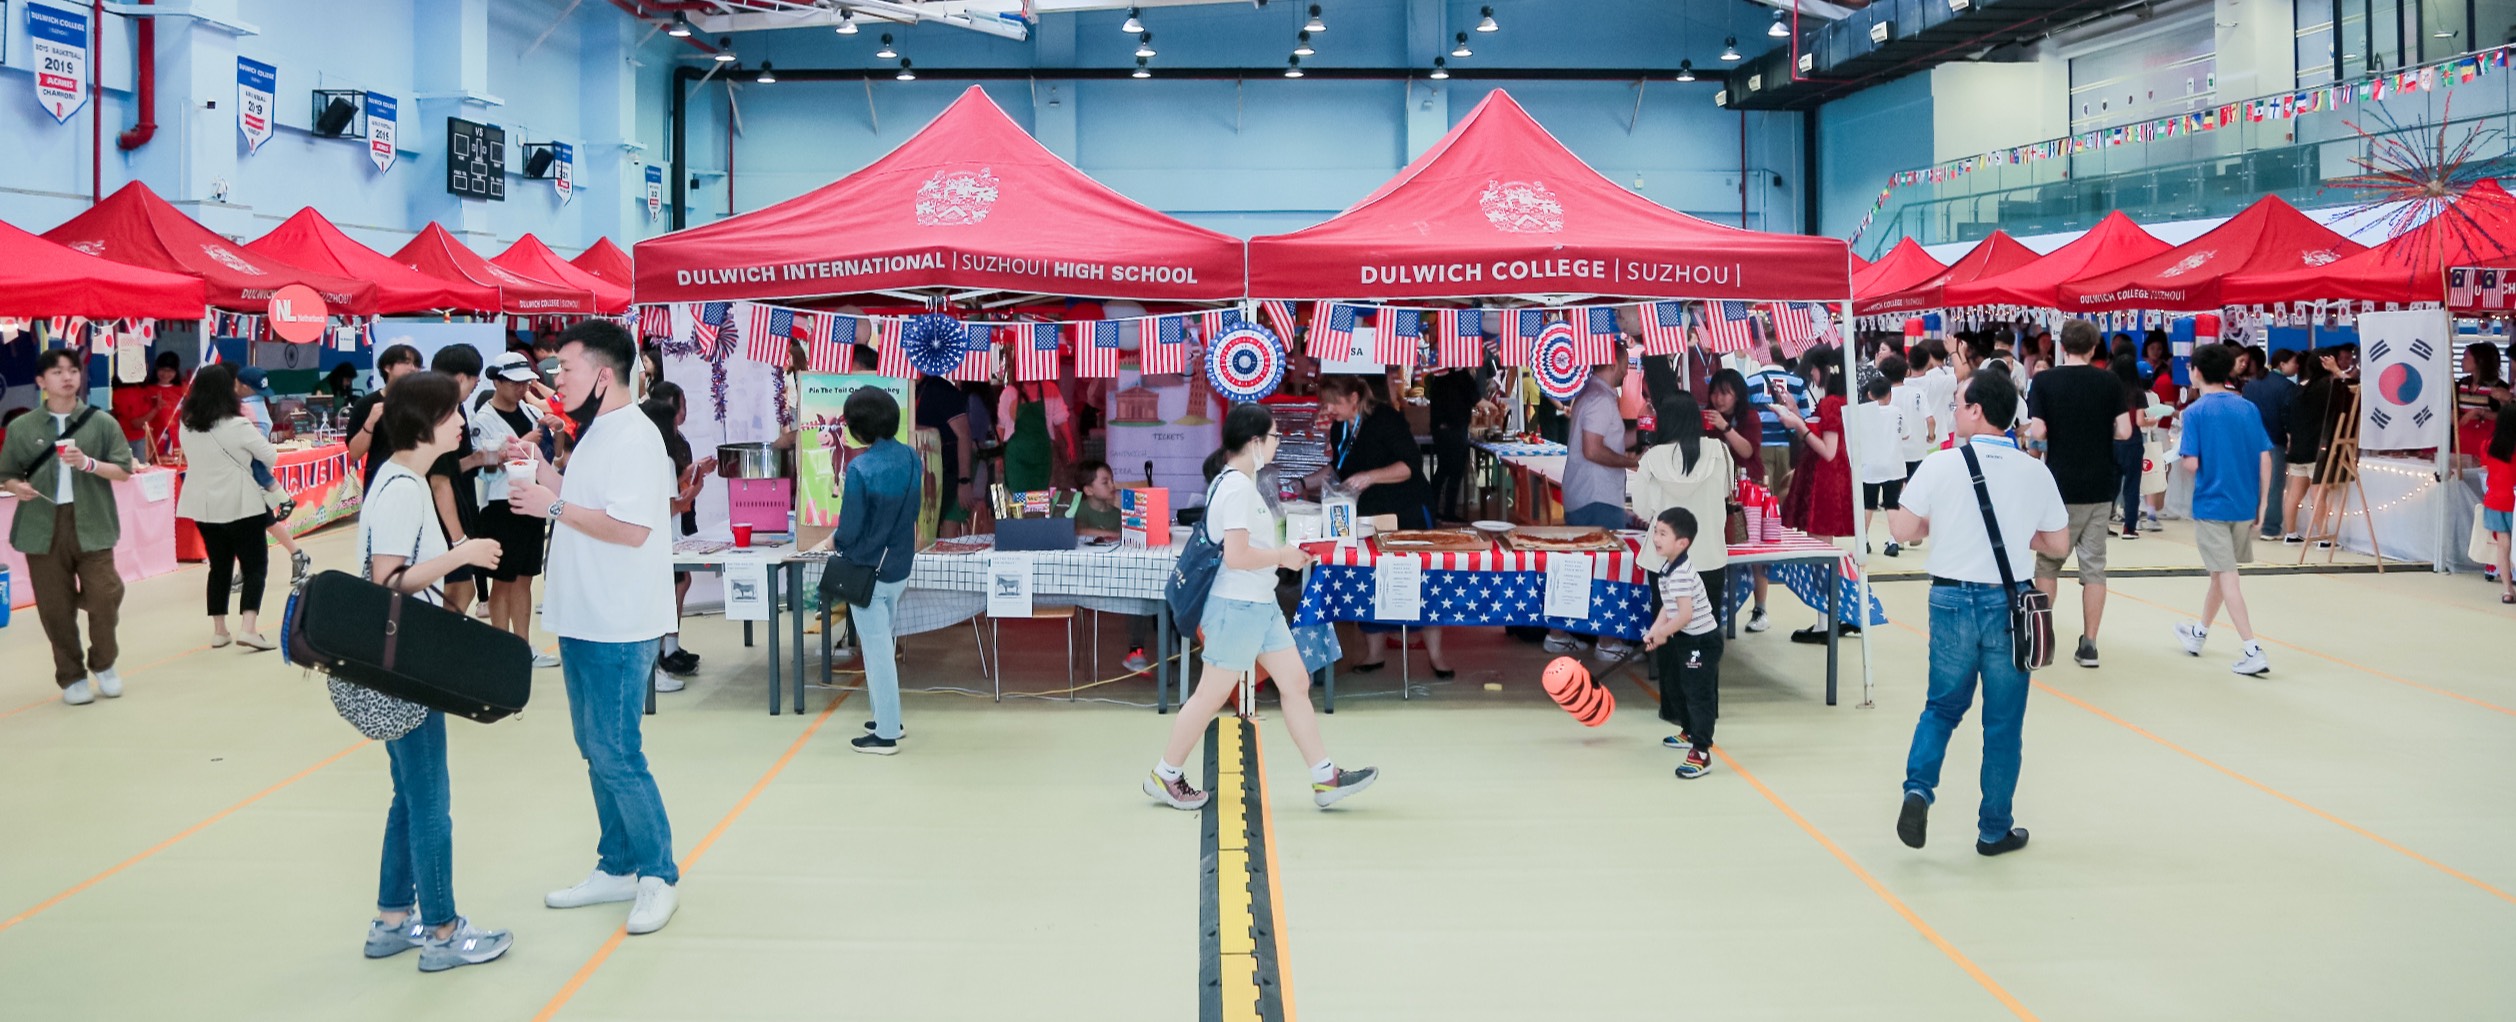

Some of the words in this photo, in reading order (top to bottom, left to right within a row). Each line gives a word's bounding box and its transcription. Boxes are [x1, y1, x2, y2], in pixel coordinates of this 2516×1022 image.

[44, 57, 73, 74] 2019
[475, 127, 484, 137] VS
[677, 265, 776, 286] DULWICH
[783, 252, 945, 281] INTERNATIONAL
[962, 254, 1039, 275] SUZHOU
[1054, 261, 1104, 280] HIGH
[1111, 264, 1198, 284] SCHOOL
[1361, 263, 1482, 284] DULWICH
[1491, 259, 1605, 280] COLLEGE
[1627, 262, 1729, 284] SUZHOU
[2116, 288, 2149, 300] COLLEGE
[1883, 298, 1903, 308] COLLEGE
[275, 299, 297, 322] NL
[1152, 432, 1185, 441] TICKETS
[463, 938, 478, 951] N
